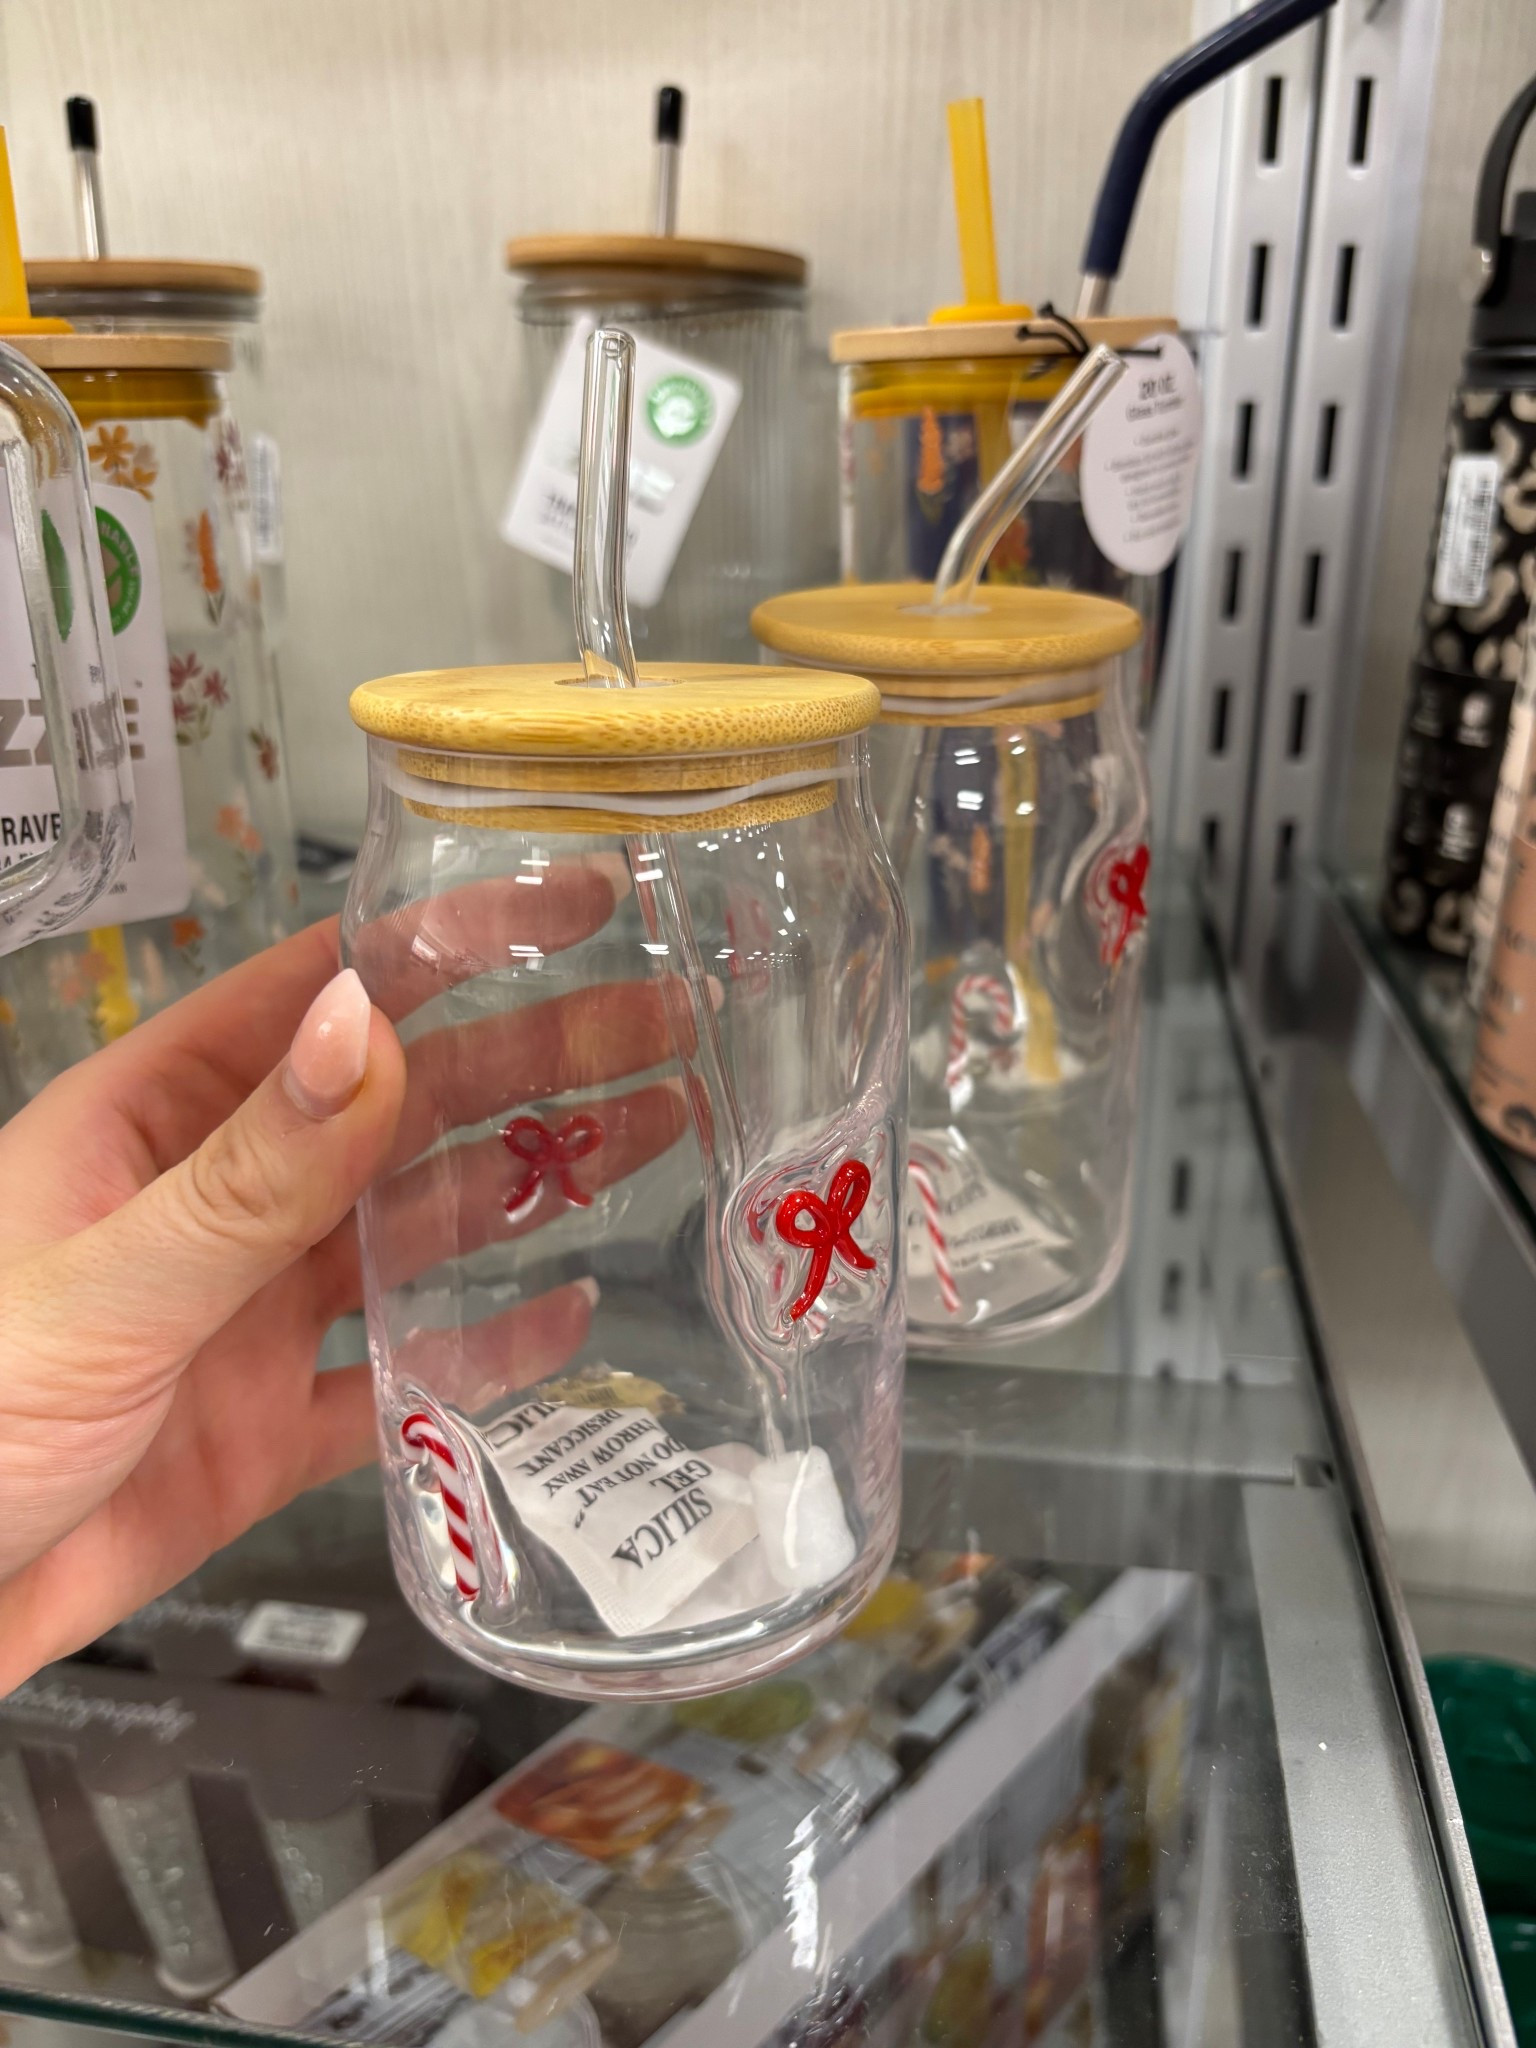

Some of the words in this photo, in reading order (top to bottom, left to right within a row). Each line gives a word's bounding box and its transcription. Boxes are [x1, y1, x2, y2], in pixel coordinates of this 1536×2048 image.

[513, 1408, 622, 1477] DESICCANT
[591, 1418, 661, 1465] THROW
[652, 1435, 686, 1460] DO
[539, 1458, 593, 1498] AWAY
[613, 1451, 658, 1482] NOT
[648, 1459, 712, 1493] GEL
[611, 1487, 713, 1569] SILICA
